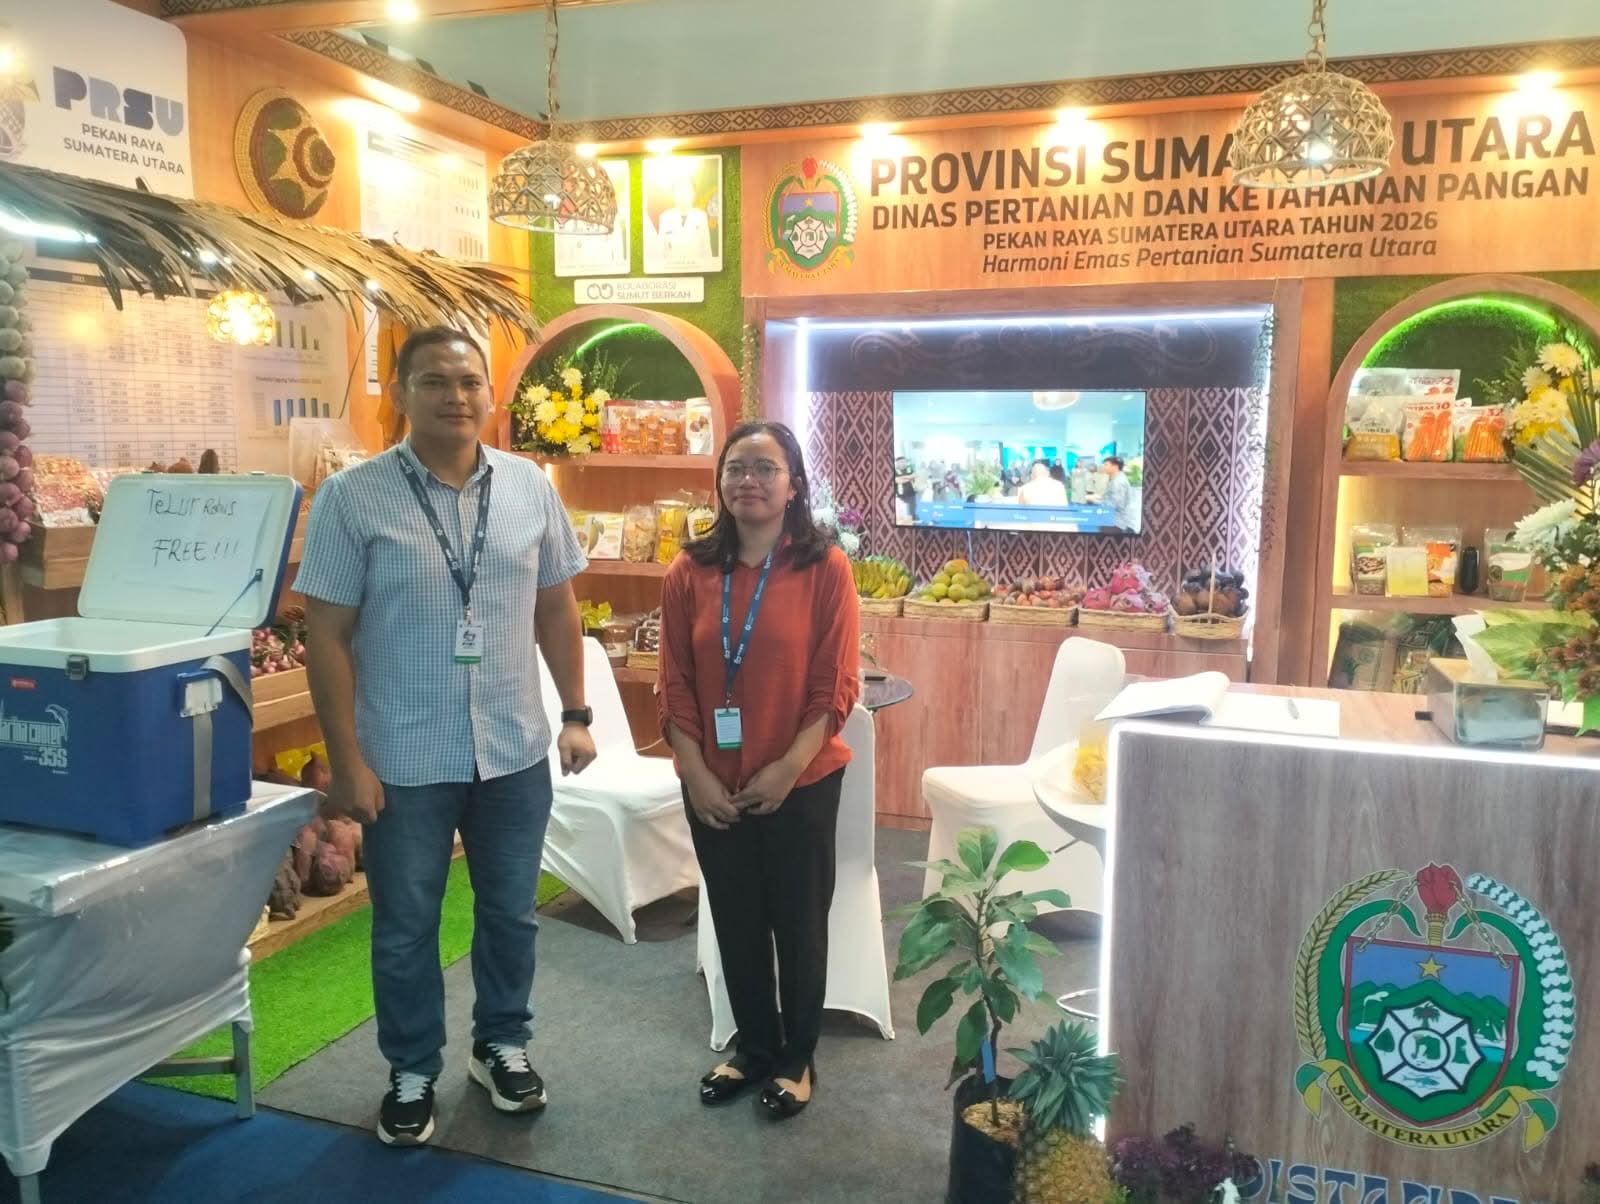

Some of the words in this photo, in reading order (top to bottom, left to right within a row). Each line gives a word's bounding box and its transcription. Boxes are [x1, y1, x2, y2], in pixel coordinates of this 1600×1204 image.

[53, 66, 184, 136] PRSU
[64, 138, 139, 165] SUMATERA
[142, 156, 184, 175] UTARA
[81, 123, 128, 145] PEKAN
[131, 135, 164, 154] RAYA
[870, 145, 1087, 197] PROVINSI
[1402, 110, 1596, 166] UTARA
[872, 200, 958, 231] DINAS
[965, 192, 1134, 227] PERTANIAN
[1144, 187, 1208, 217] DAN
[1218, 175, 1426, 213] KETAHANAN
[1437, 166, 1591, 202] PANGAN
[983, 231, 1047, 250] PEKAN
[1053, 229, 1104, 247] RAYA
[1108, 223, 1219, 245] SUMATERA
[1224, 218, 1295, 239] UTARA
[1300, 214, 1374, 236] TAHUN
[1380, 211, 1438, 231] 2026
[982, 252, 1068, 273] Harmoni
[1074, 250, 1130, 271] Emas
[1136, 242, 1244, 268] Pertanian
[1249, 240, 1362, 263] Sumatera
[1369, 237, 1437, 258] Utara
[617, 290, 649, 300] SUMUT
[652, 289, 691, 300] BERKAH
[39, 746, 67, 768] 35S
[1333, 1084, 1438, 1146] SUMATERA
[1443, 1111, 1513, 1144] UTARA
